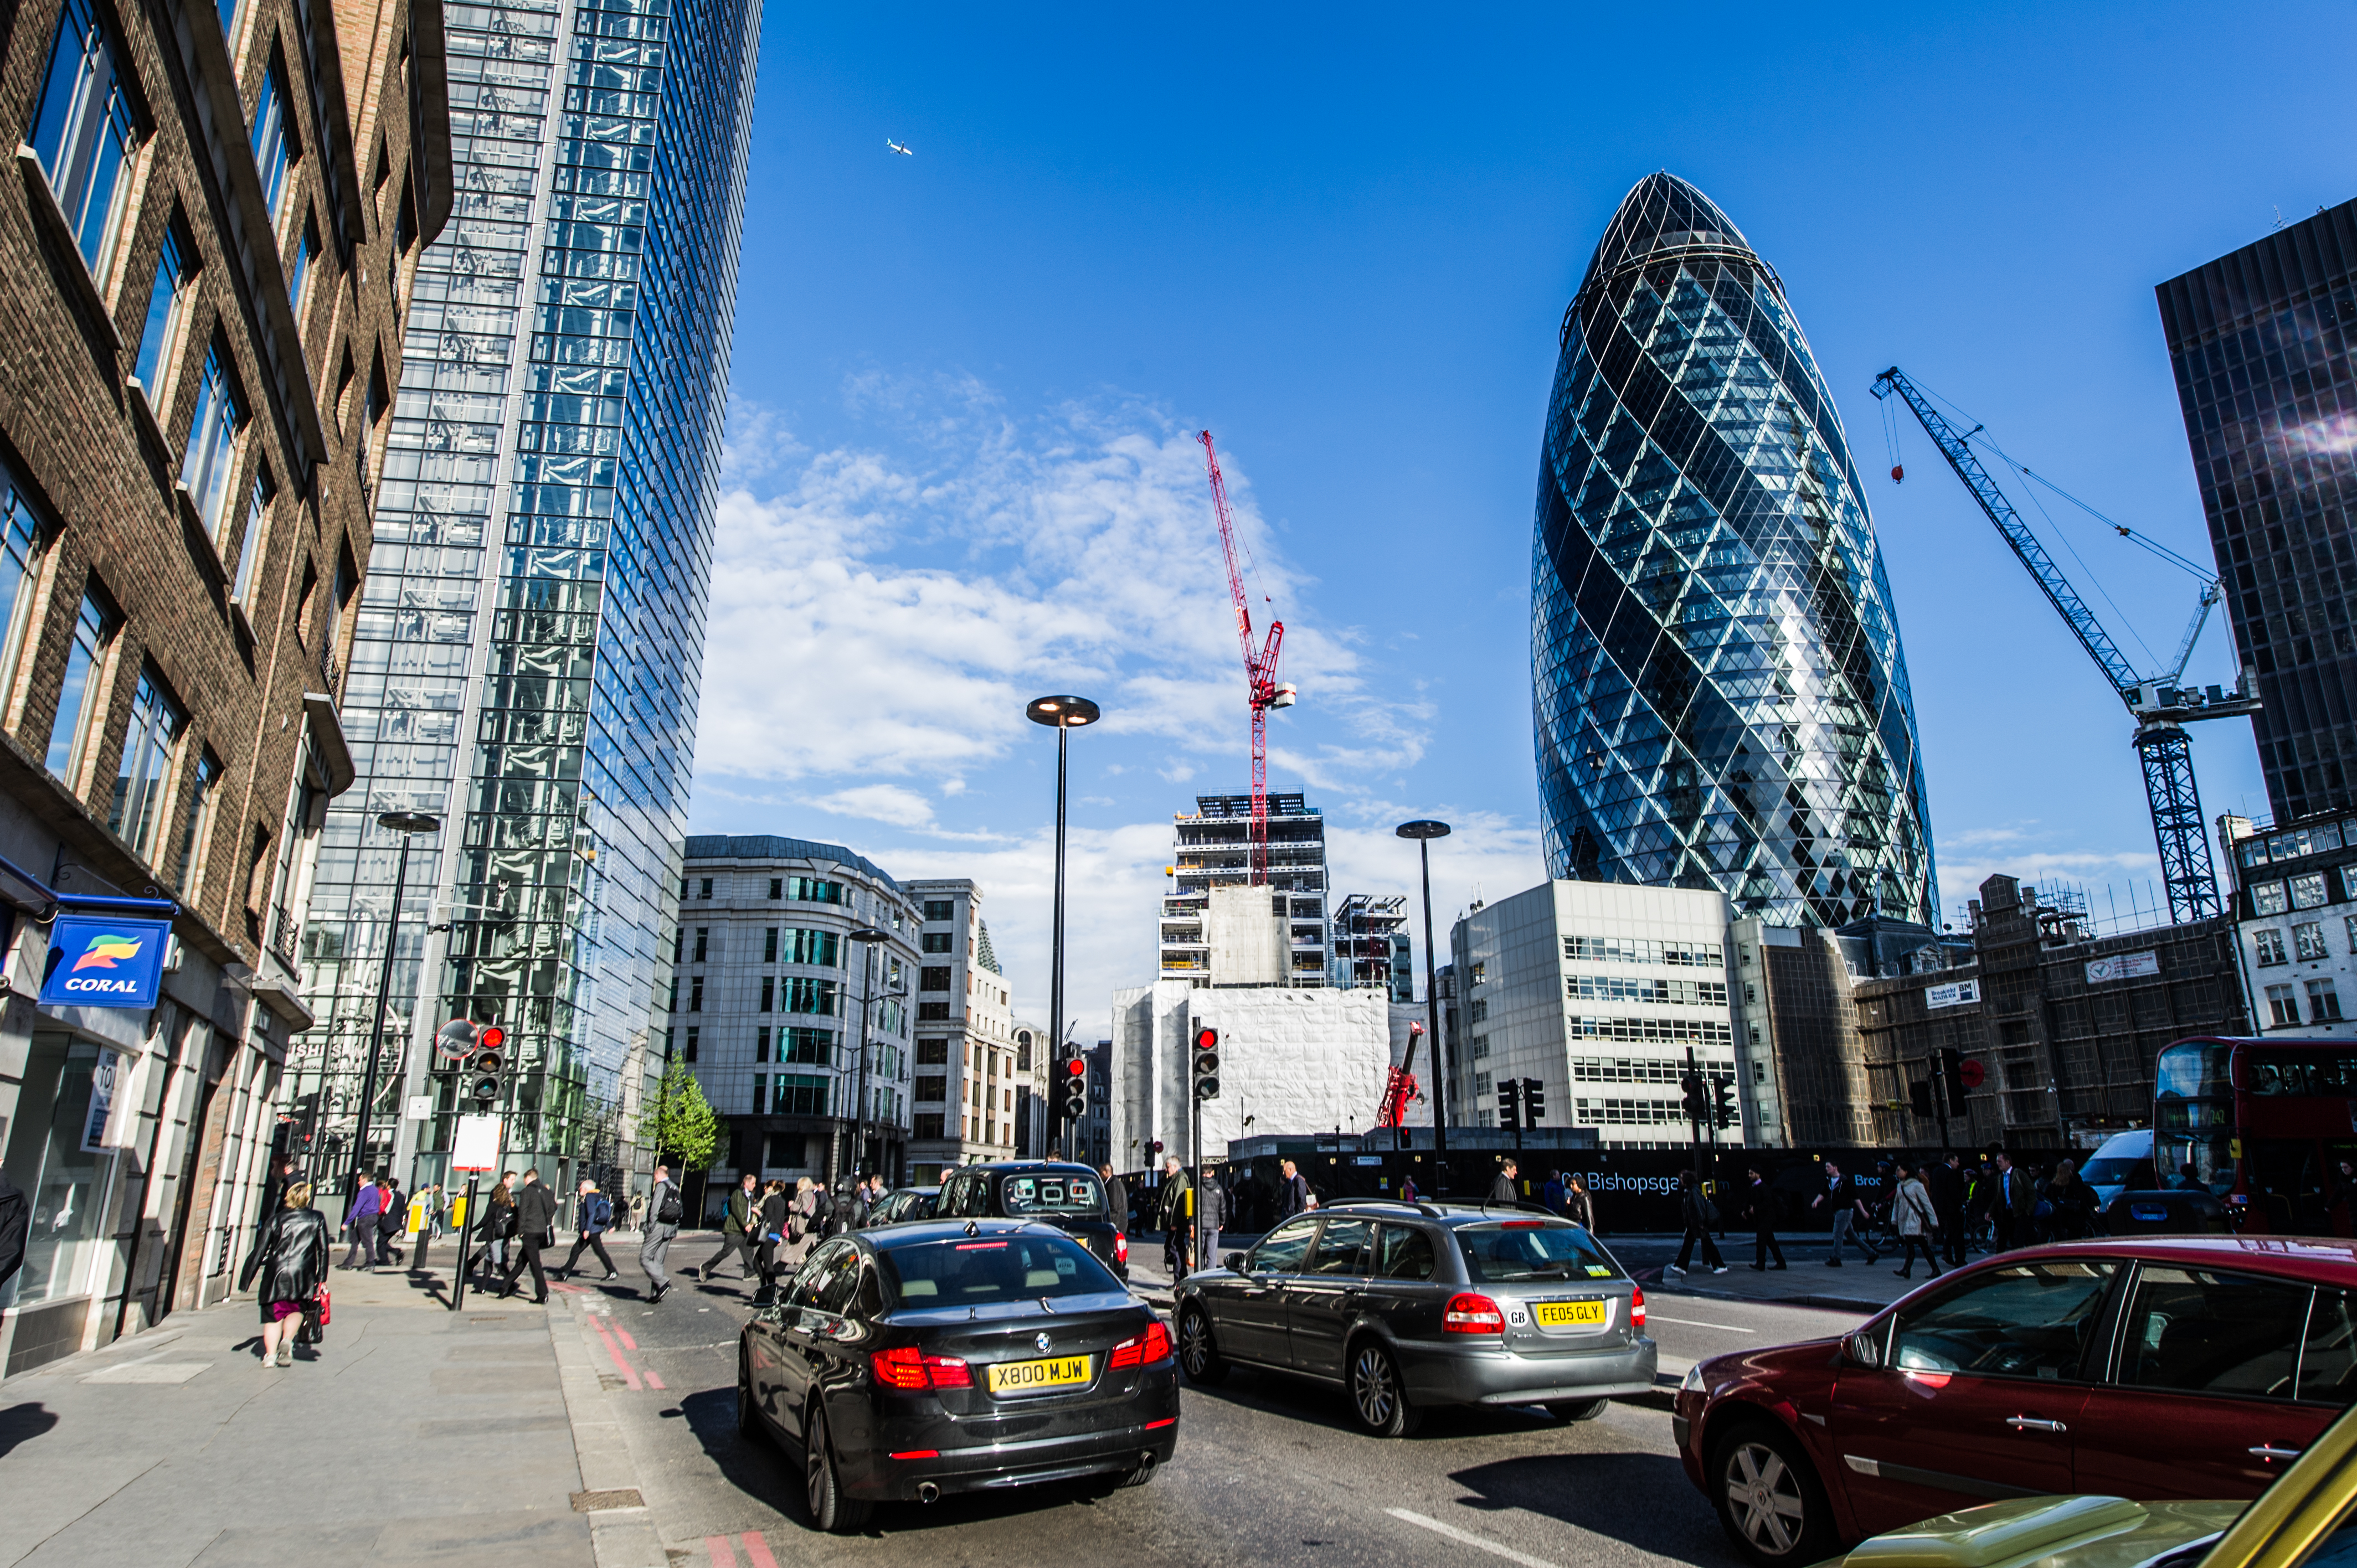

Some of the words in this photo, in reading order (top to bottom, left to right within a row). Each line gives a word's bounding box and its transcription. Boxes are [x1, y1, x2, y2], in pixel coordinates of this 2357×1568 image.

[65, 978, 137, 993] CORAL
[1958, 983, 1972, 992] BM
[2210, 1109, 2225, 1124] 242
[1587, 1172, 1679, 1196] Bishopsga
[1511, 1312, 1525, 1324] GB
[1542, 1307, 1574, 1322] FE05
[1576, 1306, 1598, 1320] GLY
[998, 1365, 1044, 1386] X800
[1049, 1360, 1082, 1380] MJW
